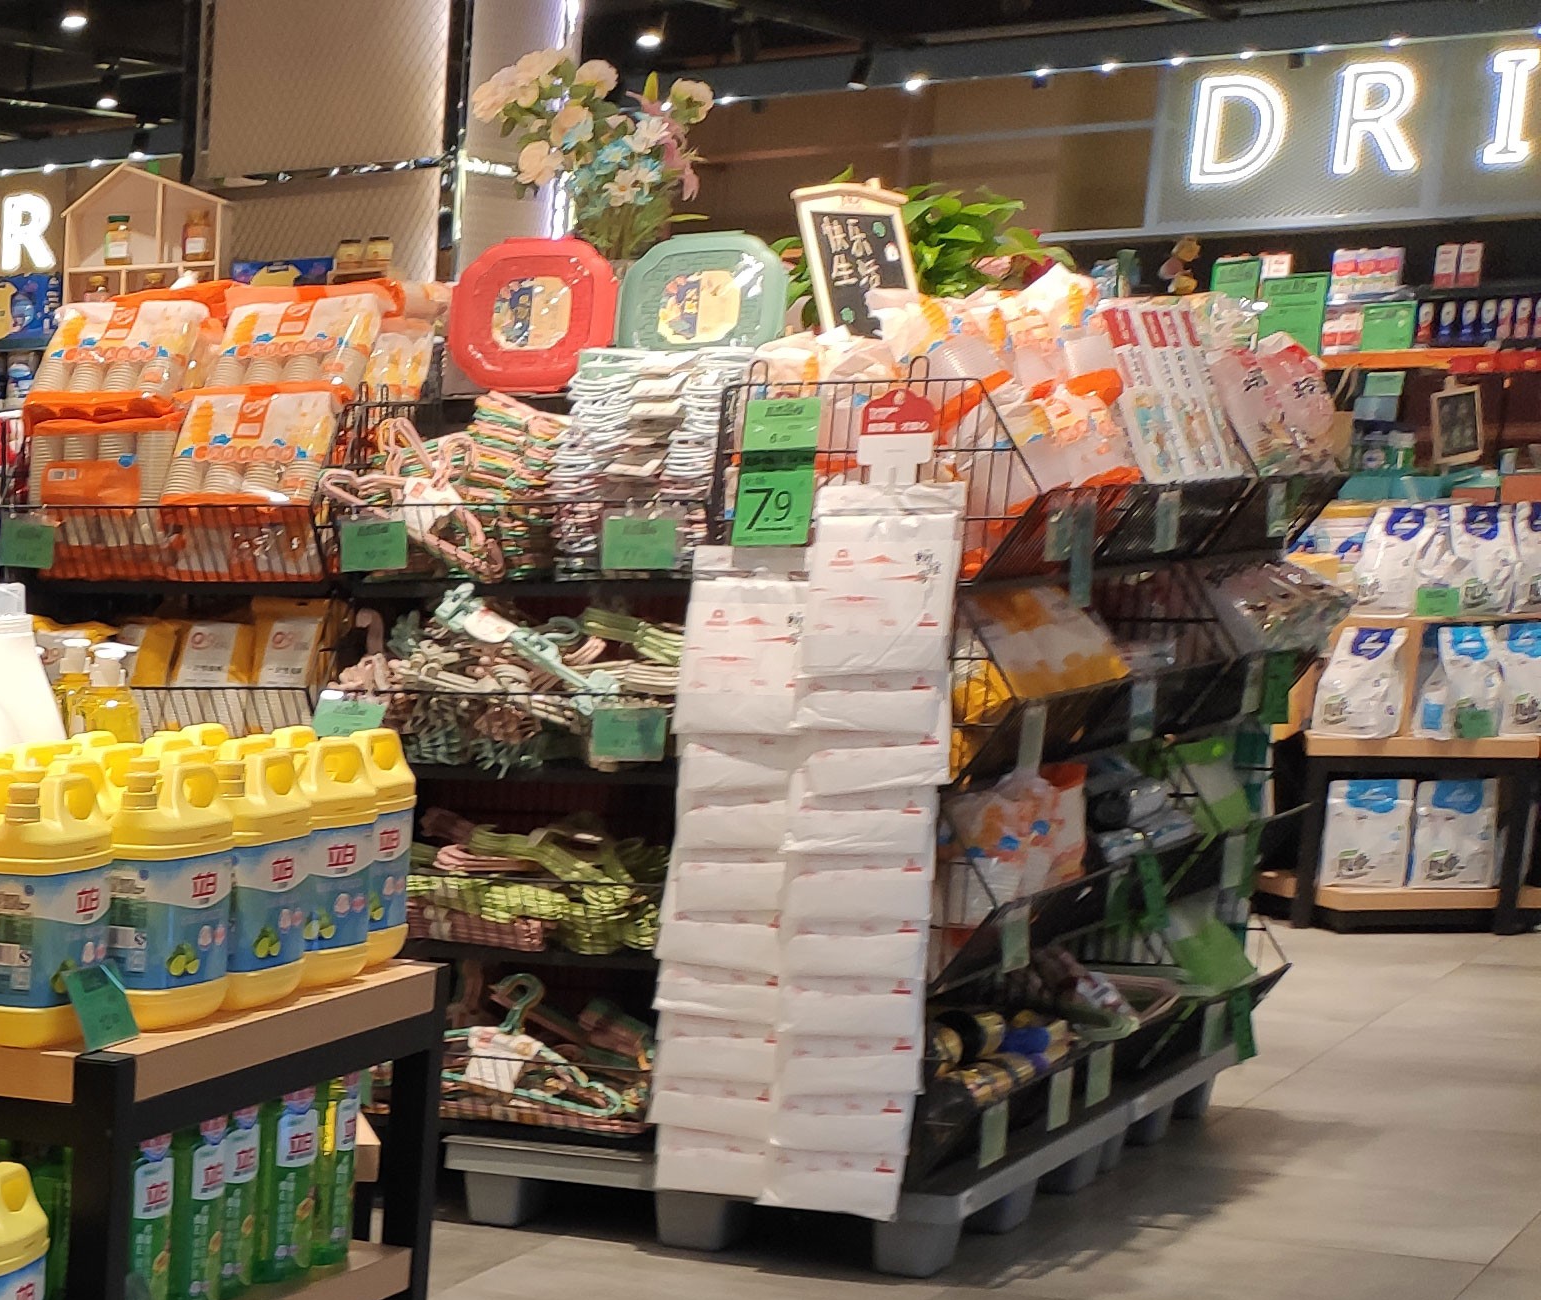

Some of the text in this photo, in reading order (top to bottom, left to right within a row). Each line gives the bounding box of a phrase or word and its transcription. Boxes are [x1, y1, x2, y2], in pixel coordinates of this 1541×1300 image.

[820, 215, 874, 258] 快乐
[743, 486, 793, 531] 7.9
[378, 827, 401, 852] 立白
[271, 856, 295, 883] 立白
[326, 842, 357, 869] 立白
[191, 870, 218, 898] 立白
[75, 886, 101, 914] 立白
